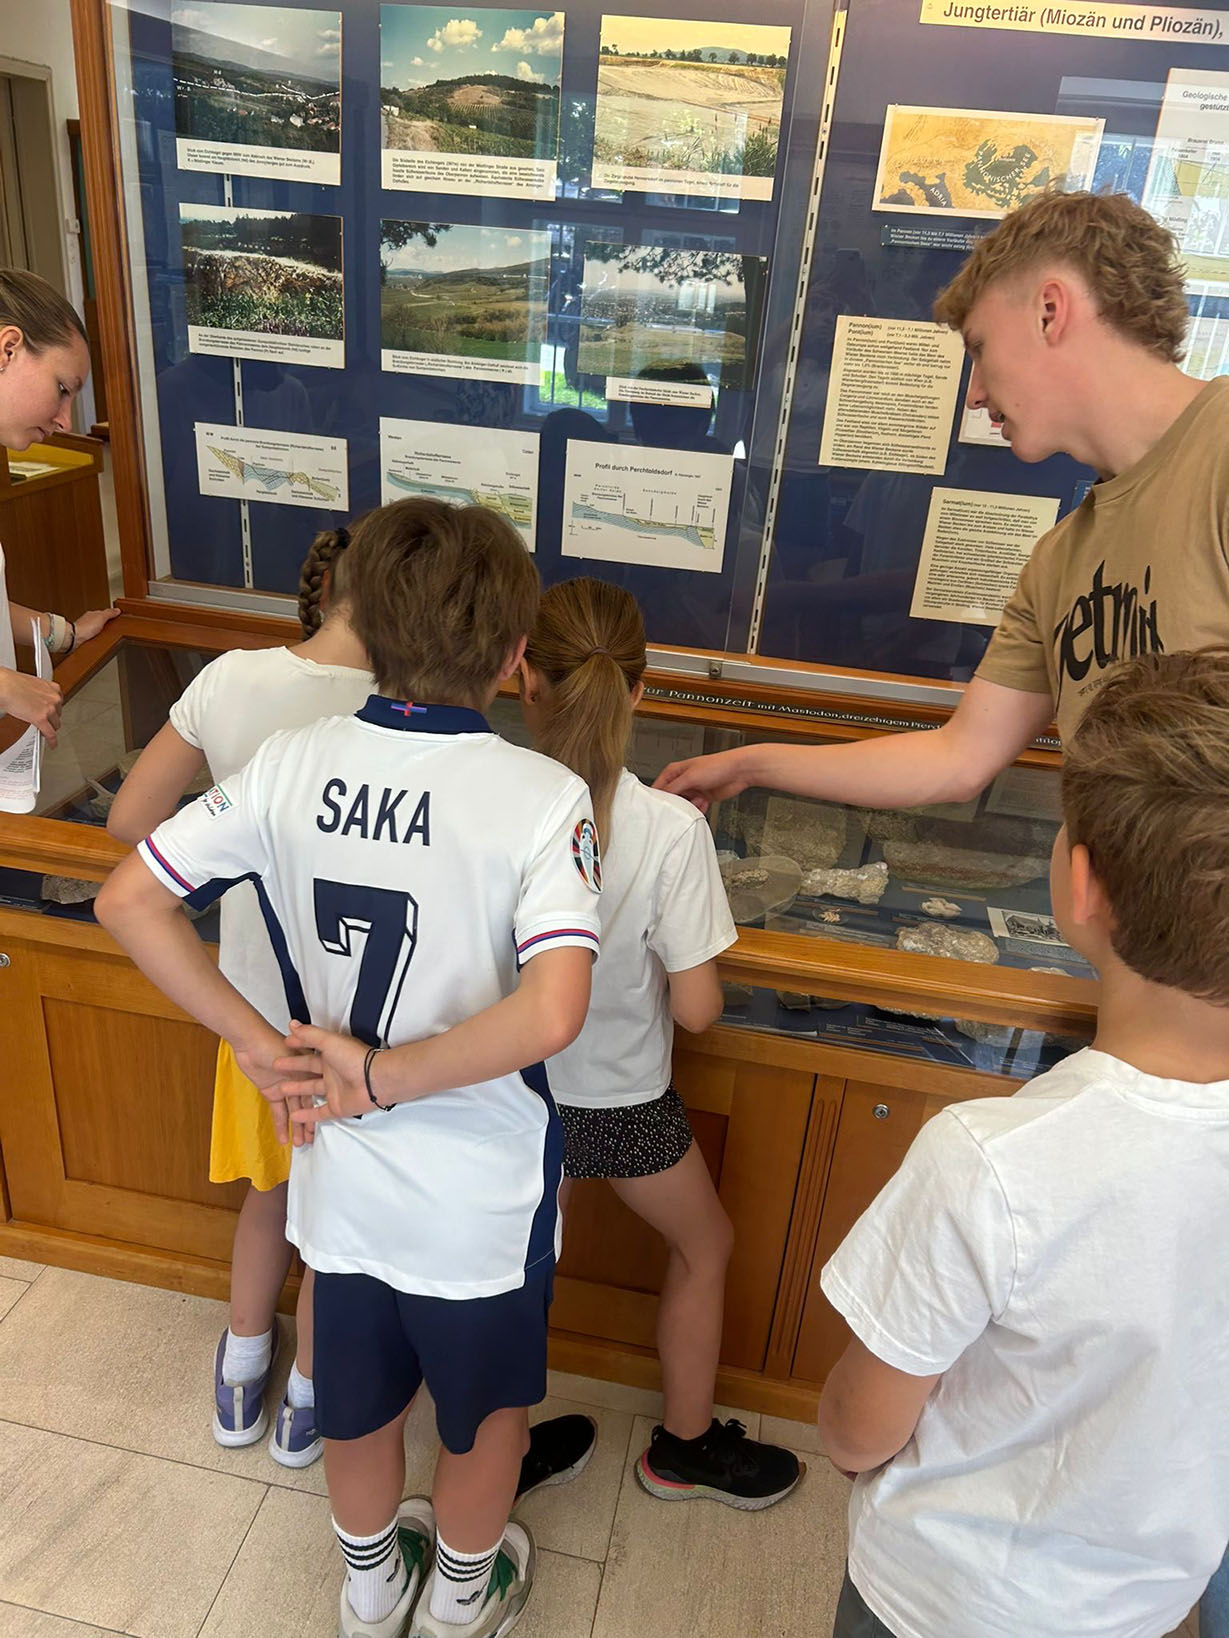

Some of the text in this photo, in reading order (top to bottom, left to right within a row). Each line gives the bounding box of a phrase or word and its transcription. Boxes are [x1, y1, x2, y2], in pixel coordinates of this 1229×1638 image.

[943, 2, 1224, 39] Jungtertiär (Miozän und Pliozän),
[1182, 90, 1228, 101] Geologische
[977, 150, 1032, 183] PANNONISCHER SEE
[929, 187, 948, 207] ADRIA
[630, 466, 673, 477] Perchtoldsdorf
[668, 690, 754, 708] Pannonzeit
[757, 704, 776, 712] mit
[316, 777, 431, 847] SAKA
[313, 877, 419, 1048] 7
